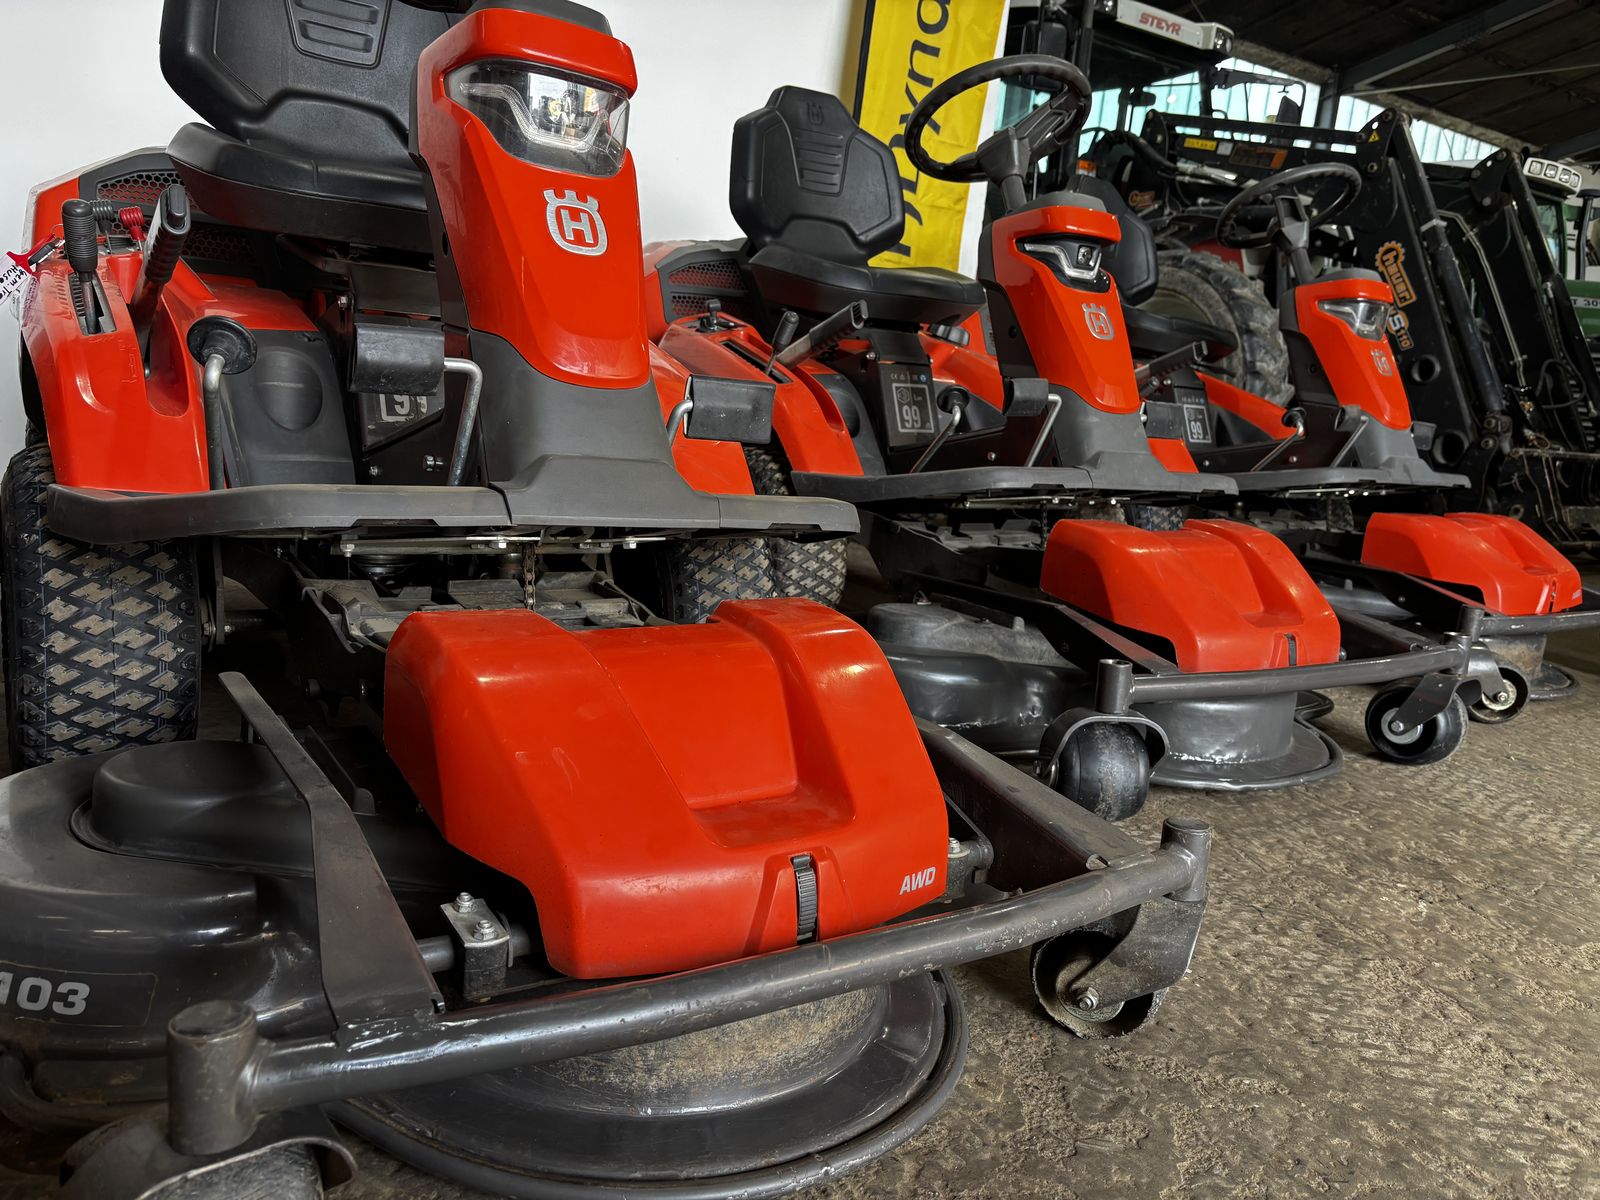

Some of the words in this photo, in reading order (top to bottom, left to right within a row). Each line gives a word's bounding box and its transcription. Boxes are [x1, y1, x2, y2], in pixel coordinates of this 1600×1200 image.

[1139, 12, 1182, 36] STEYR
[1382, 249, 1411, 300] hauer
[902, 405, 921, 428] 99
[899, 866, 936, 896] AWD
[0, 971, 91, 1016] 103
